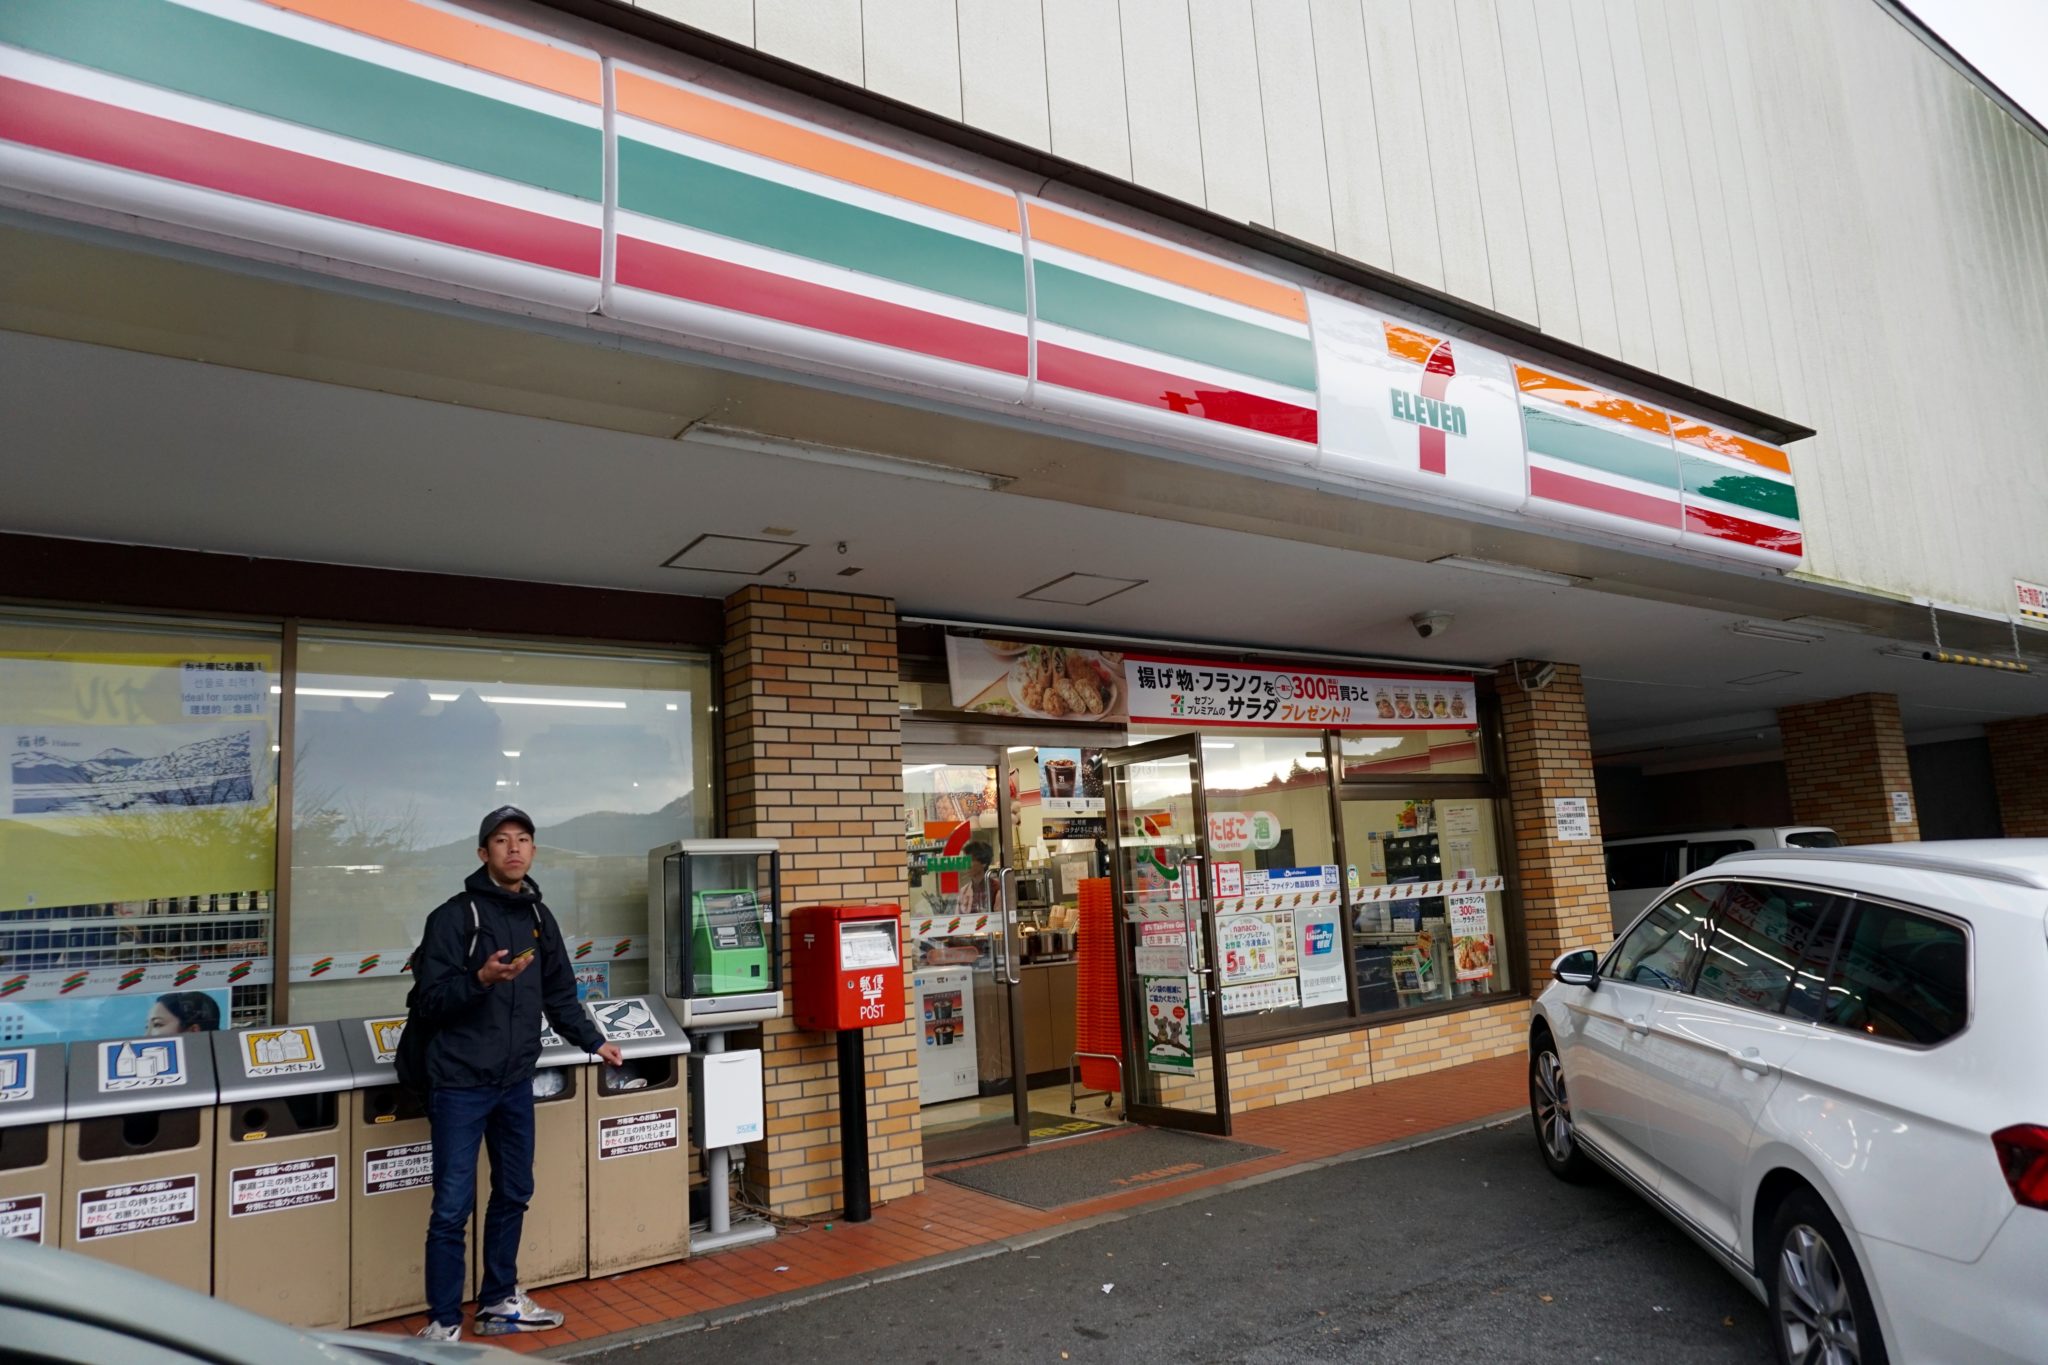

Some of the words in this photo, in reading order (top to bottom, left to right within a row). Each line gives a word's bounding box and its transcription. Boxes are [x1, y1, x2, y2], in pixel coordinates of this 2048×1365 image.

[204, 692, 219, 701] for
[222, 692, 260, 702] souvenir
[1227, 695, 1281, 720] サラダ
[1209, 817, 1248, 841] たばこ
[1306, 930, 1332, 940] UnionPay
[859, 974, 885, 992] 郵便
[860, 1003, 885, 1019] POST
[248, 1062, 322, 1075] ペットボトル
